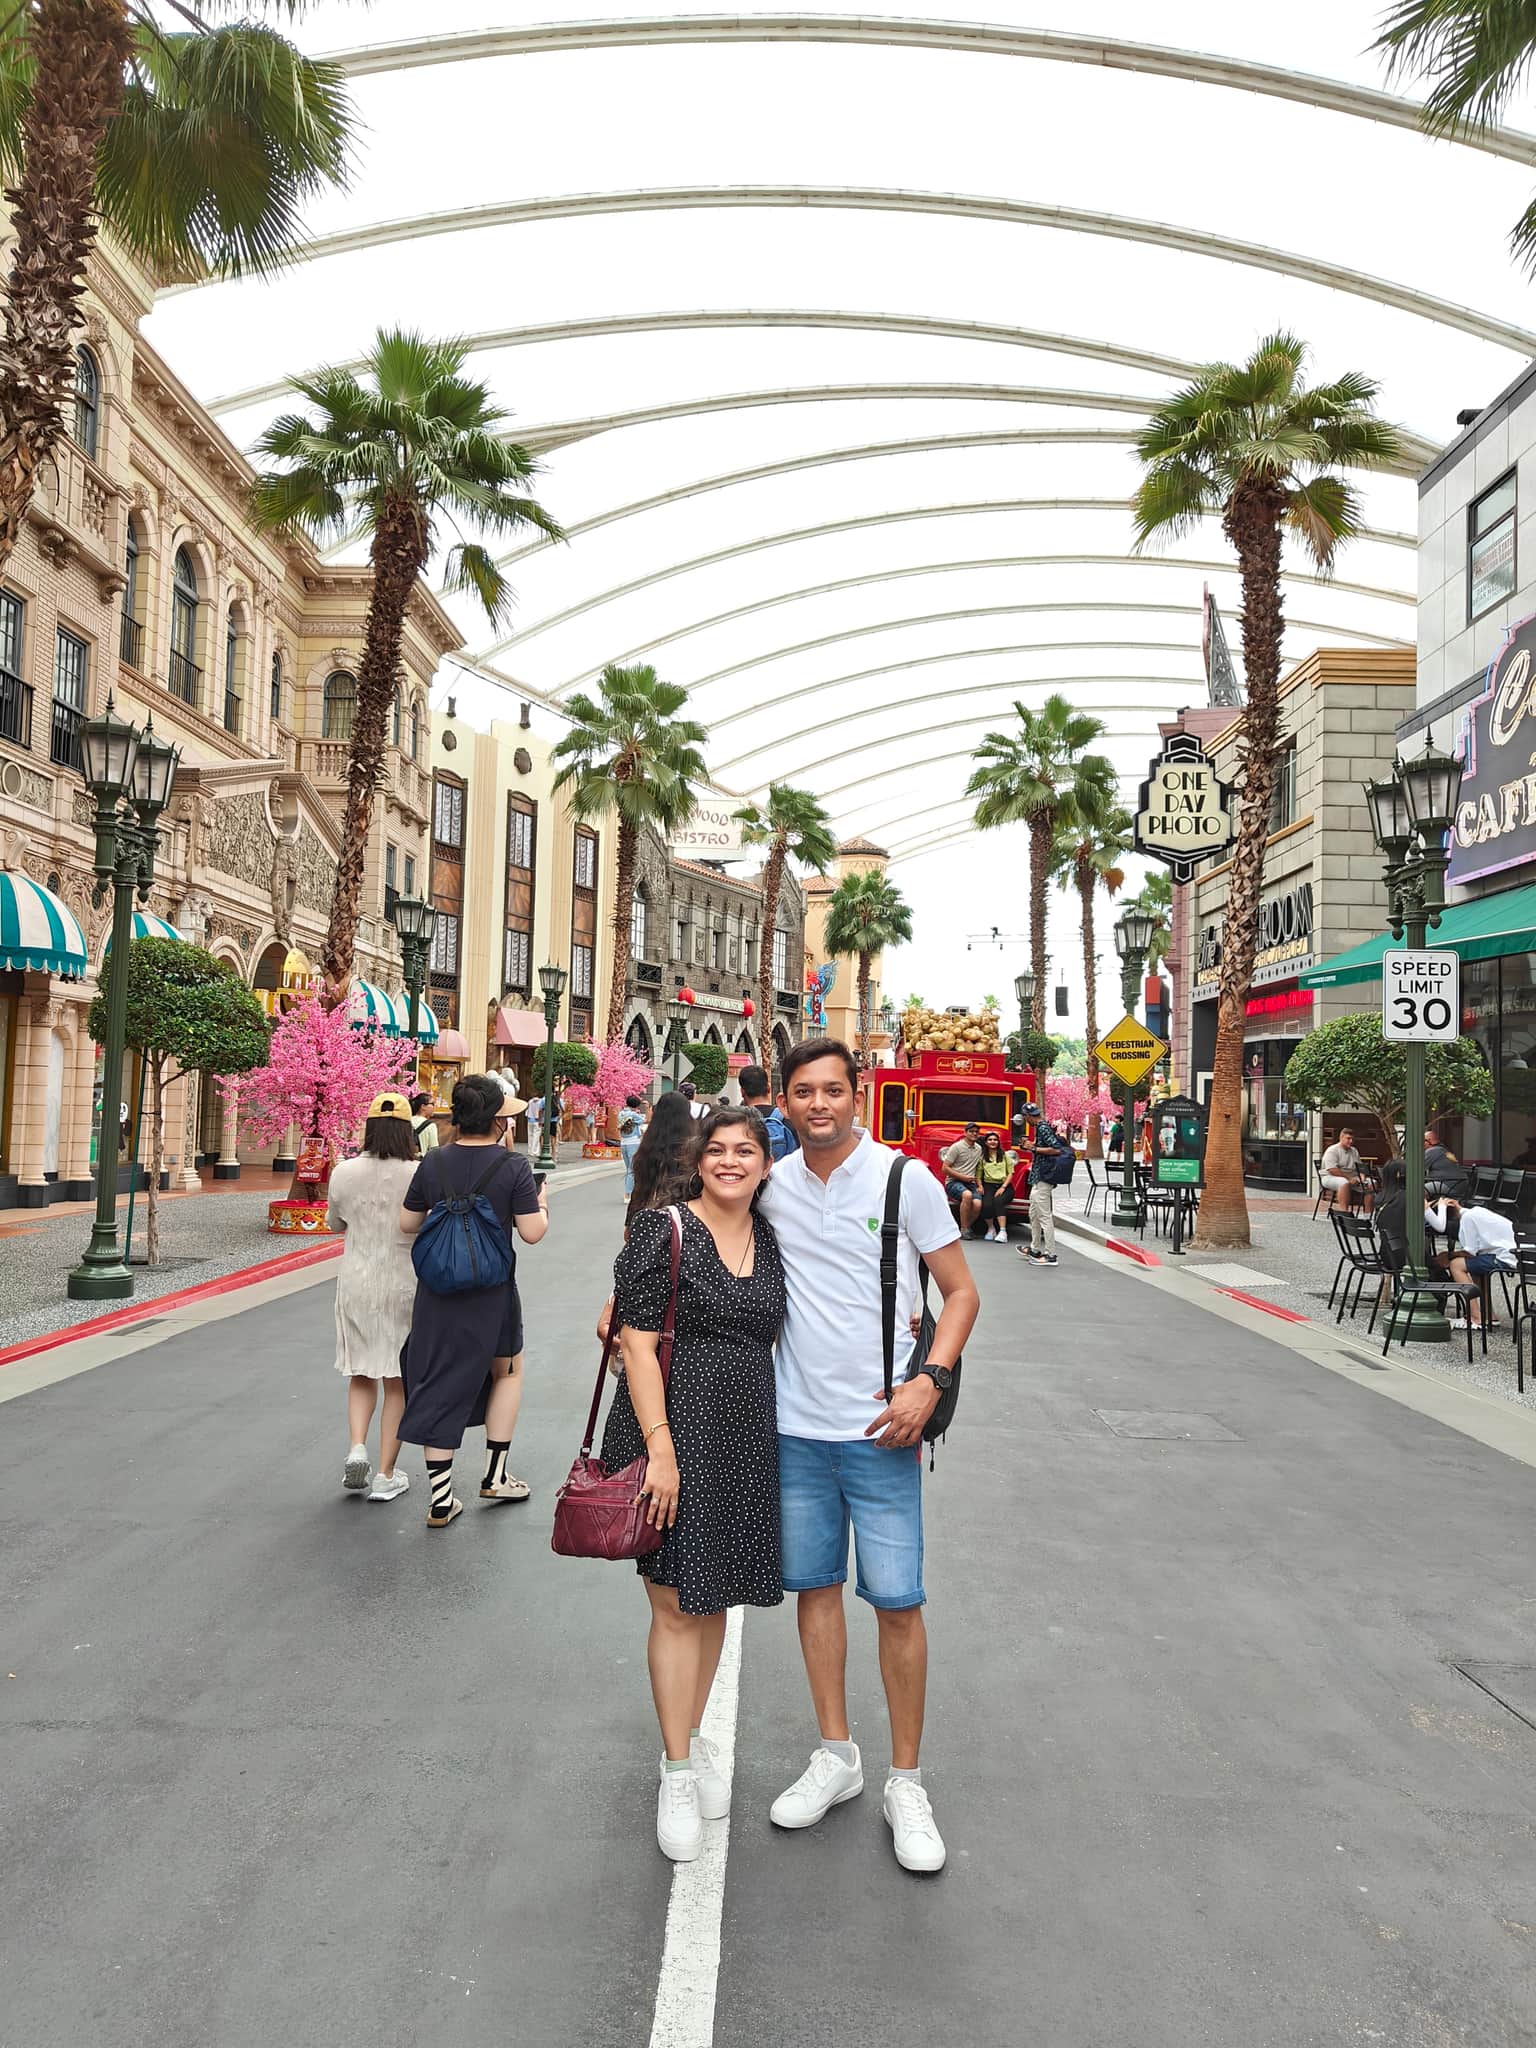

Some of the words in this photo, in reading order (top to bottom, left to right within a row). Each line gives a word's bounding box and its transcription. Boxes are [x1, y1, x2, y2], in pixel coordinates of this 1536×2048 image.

[1162, 771, 1208, 791] ONE
[1164, 793, 1206, 813] DAY
[1148, 815, 1221, 835] PHOTO
[673, 831, 730, 845] BISTRO
[1391, 961, 1451, 976] SPEED
[1399, 980, 1444, 994] LIMIT
[1391, 997, 1451, 1030] 30
[1105, 1040, 1154, 1049] PEDESTRIAN
[1110, 1051, 1151, 1060] CROSSING
